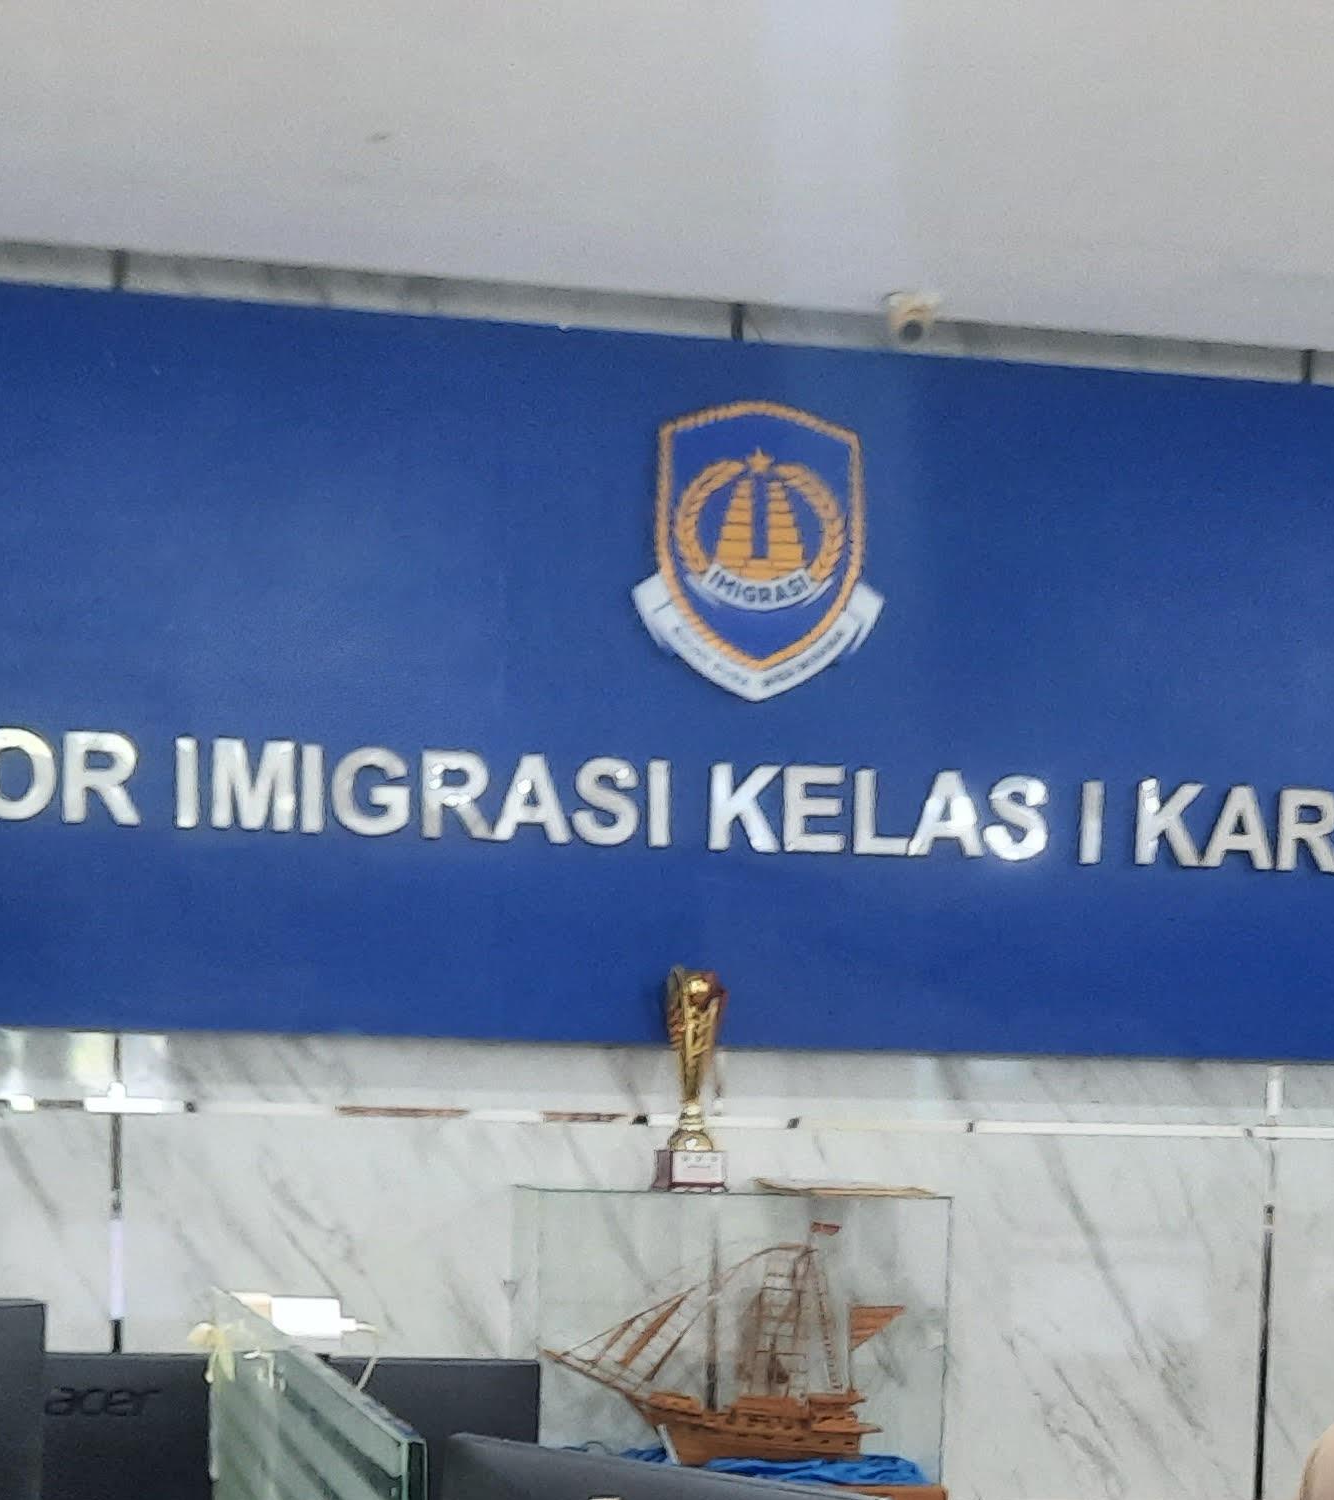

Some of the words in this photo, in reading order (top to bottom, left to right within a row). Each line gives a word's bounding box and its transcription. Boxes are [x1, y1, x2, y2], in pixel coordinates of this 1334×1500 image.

[174, 735, 671, 848] IMIGRASI
[707, 761, 1049, 862] KELAS
[1076, 778, 1106, 866] I
[44, 1385, 164, 1417] acer
